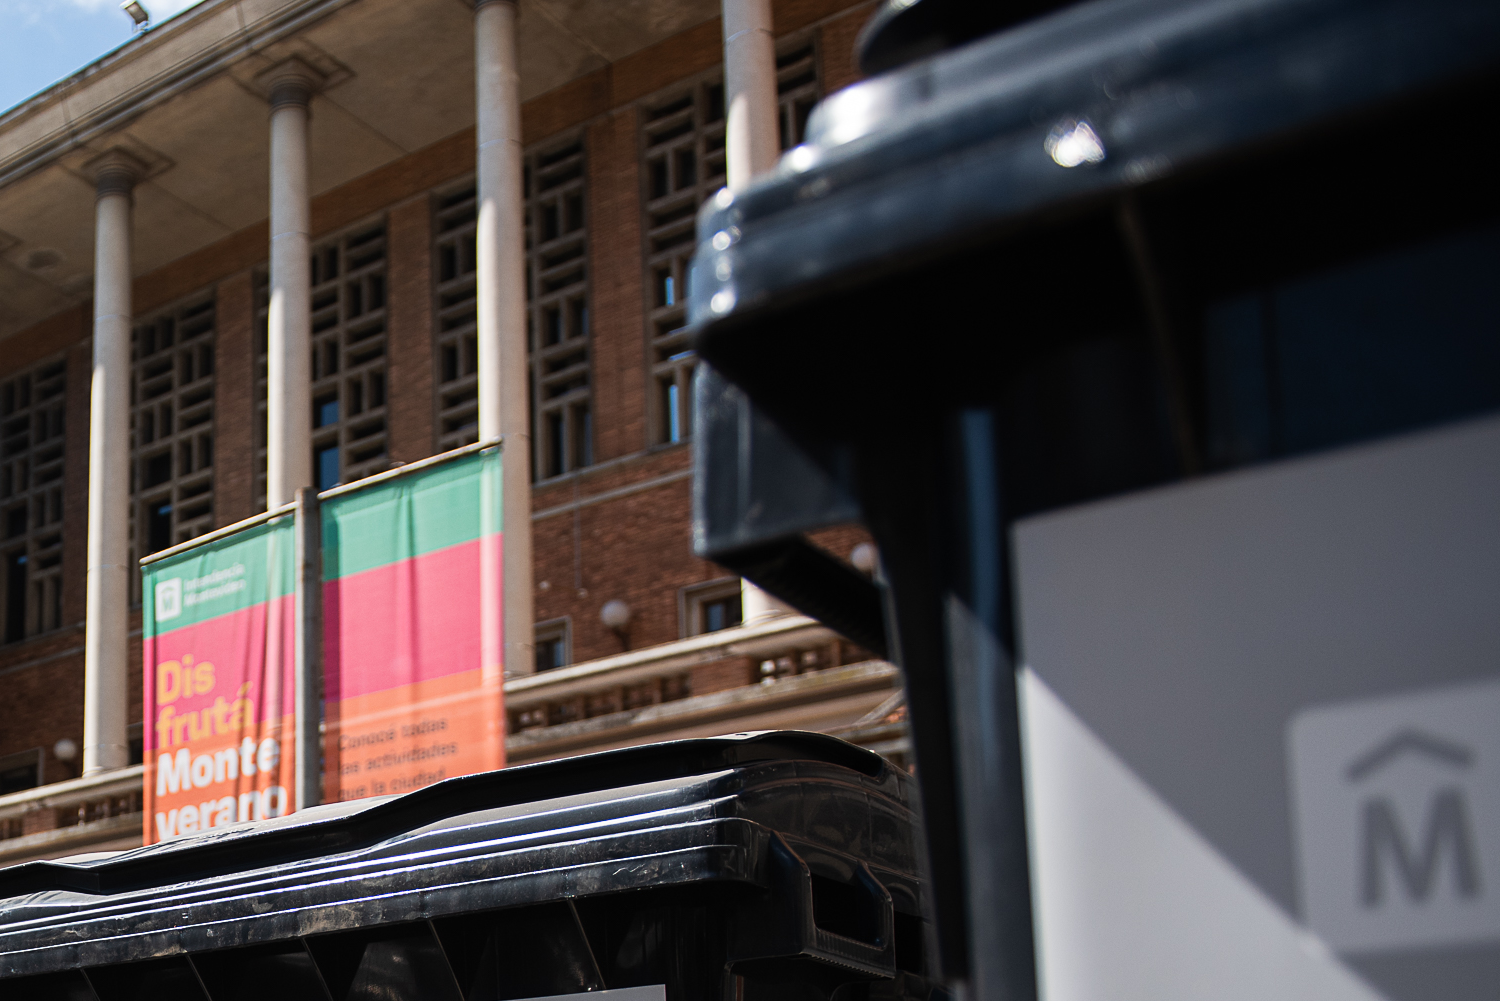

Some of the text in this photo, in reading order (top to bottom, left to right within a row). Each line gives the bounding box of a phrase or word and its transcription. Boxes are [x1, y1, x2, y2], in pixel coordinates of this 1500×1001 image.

[156, 653, 216, 706] Dis
[155, 681, 255, 749] frutá
[156, 736, 281, 797] Monte
[155, 785, 288, 841] verano
